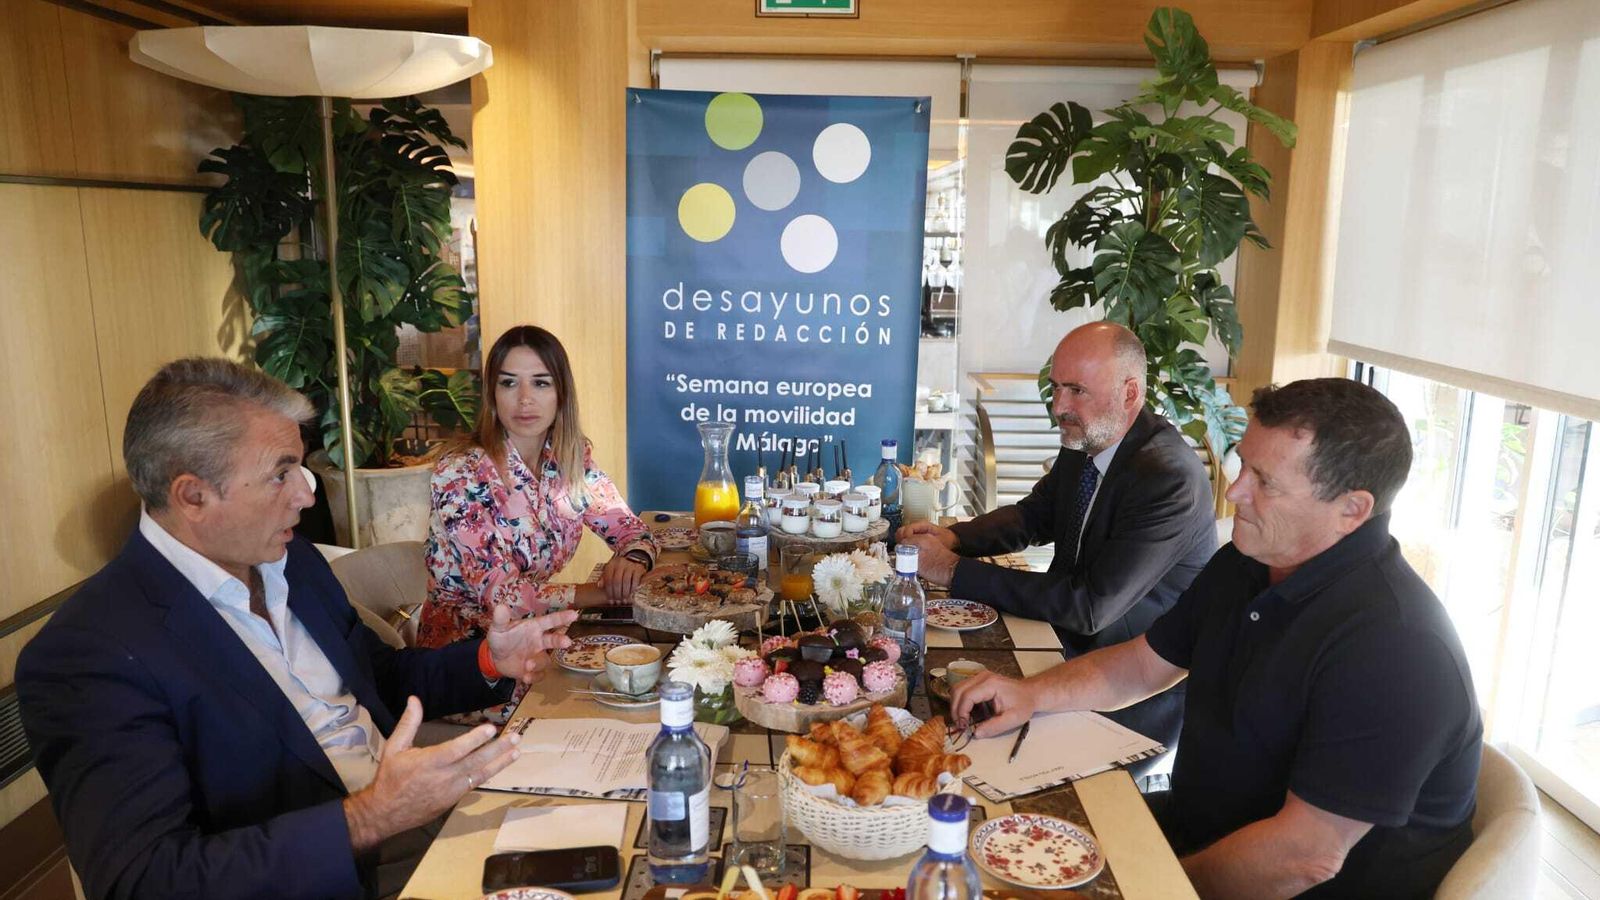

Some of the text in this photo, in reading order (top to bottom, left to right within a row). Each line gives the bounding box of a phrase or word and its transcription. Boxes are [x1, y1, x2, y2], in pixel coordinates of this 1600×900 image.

[662, 281, 891, 319] desayunos
[664, 321, 891, 345] DE REDACCIÓN
[666, 373, 872, 401] “Semana europea
[680, 402, 856, 426] de la movilidad
